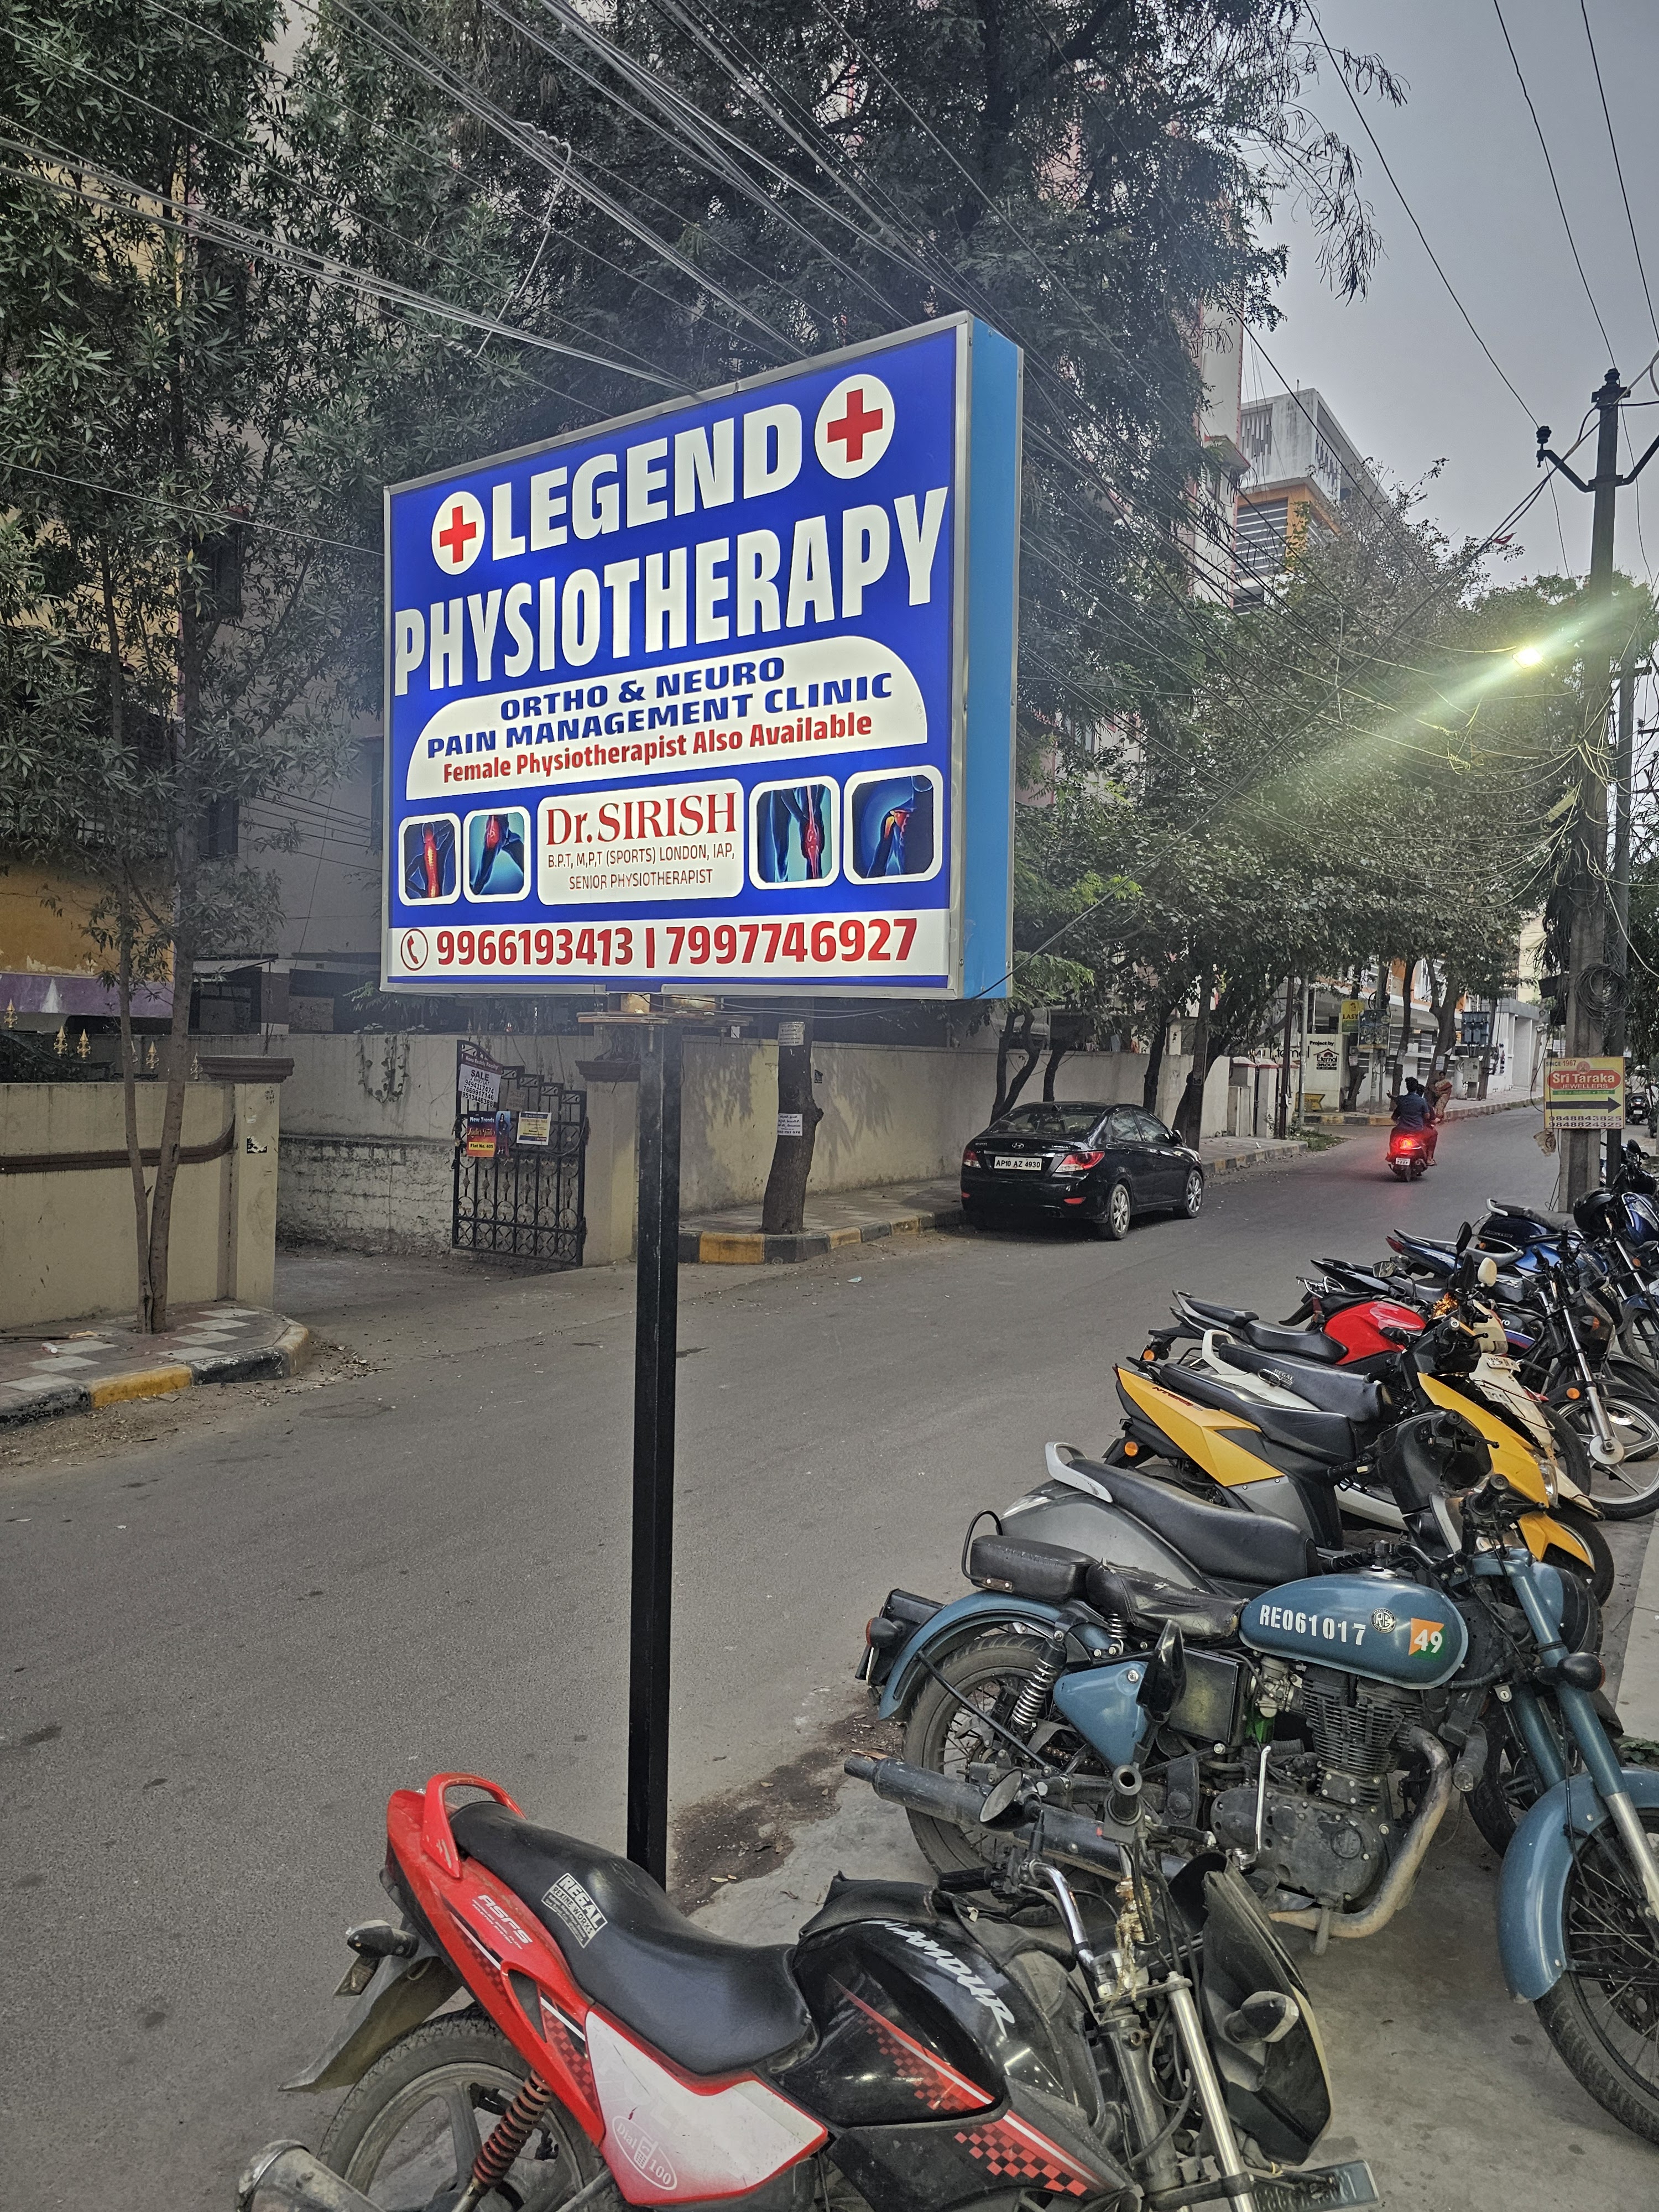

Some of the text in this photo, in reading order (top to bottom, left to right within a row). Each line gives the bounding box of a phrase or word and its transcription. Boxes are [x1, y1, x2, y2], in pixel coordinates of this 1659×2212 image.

[492, 403, 802, 561] LEGEND
[394, 487, 948, 697] PHYSIOTHERAPY
[499, 657, 785, 722] ORTHO & NEURO
[427, 672, 893, 759] PAIN MANAGEMENT CLINIC
[443, 713, 872, 783] Female Physiotherapist Also Available
[606, 847, 655, 867] (SPORTS)
[660, 844, 709, 860] LONDON,
[713, 843, 734, 859] IAP,
[569, 869, 713, 890] SENIOR PHYSIOTHERAPIST
[436, 927, 633, 967] 9966193413
[666, 917, 918, 966] 7997746927
[465, 1079, 494, 1094] 9494117474
[471, 1070, 489, 1081] SALE
[1552, 1073, 1615, 1083] Sri Taraka
[462, 1092, 493, 1107] 9513446388
[463, 1086, 494, 1100] 7669917146
[996, 1159, 1040, 1168] AP10 AZ 4930
[1273, 1369, 1295, 1381] REGAL
[1414, 1629, 1443, 1653] 49
[553, 1887, 573, 1907] REXINE
[558, 1876, 602, 1928] REGAL
[477, 1895, 533, 1943] ASFS
[572, 1906, 593, 1934] WORKS
[617, 2122, 638, 2149] Dial
[649, 2159, 671, 2185] 100
